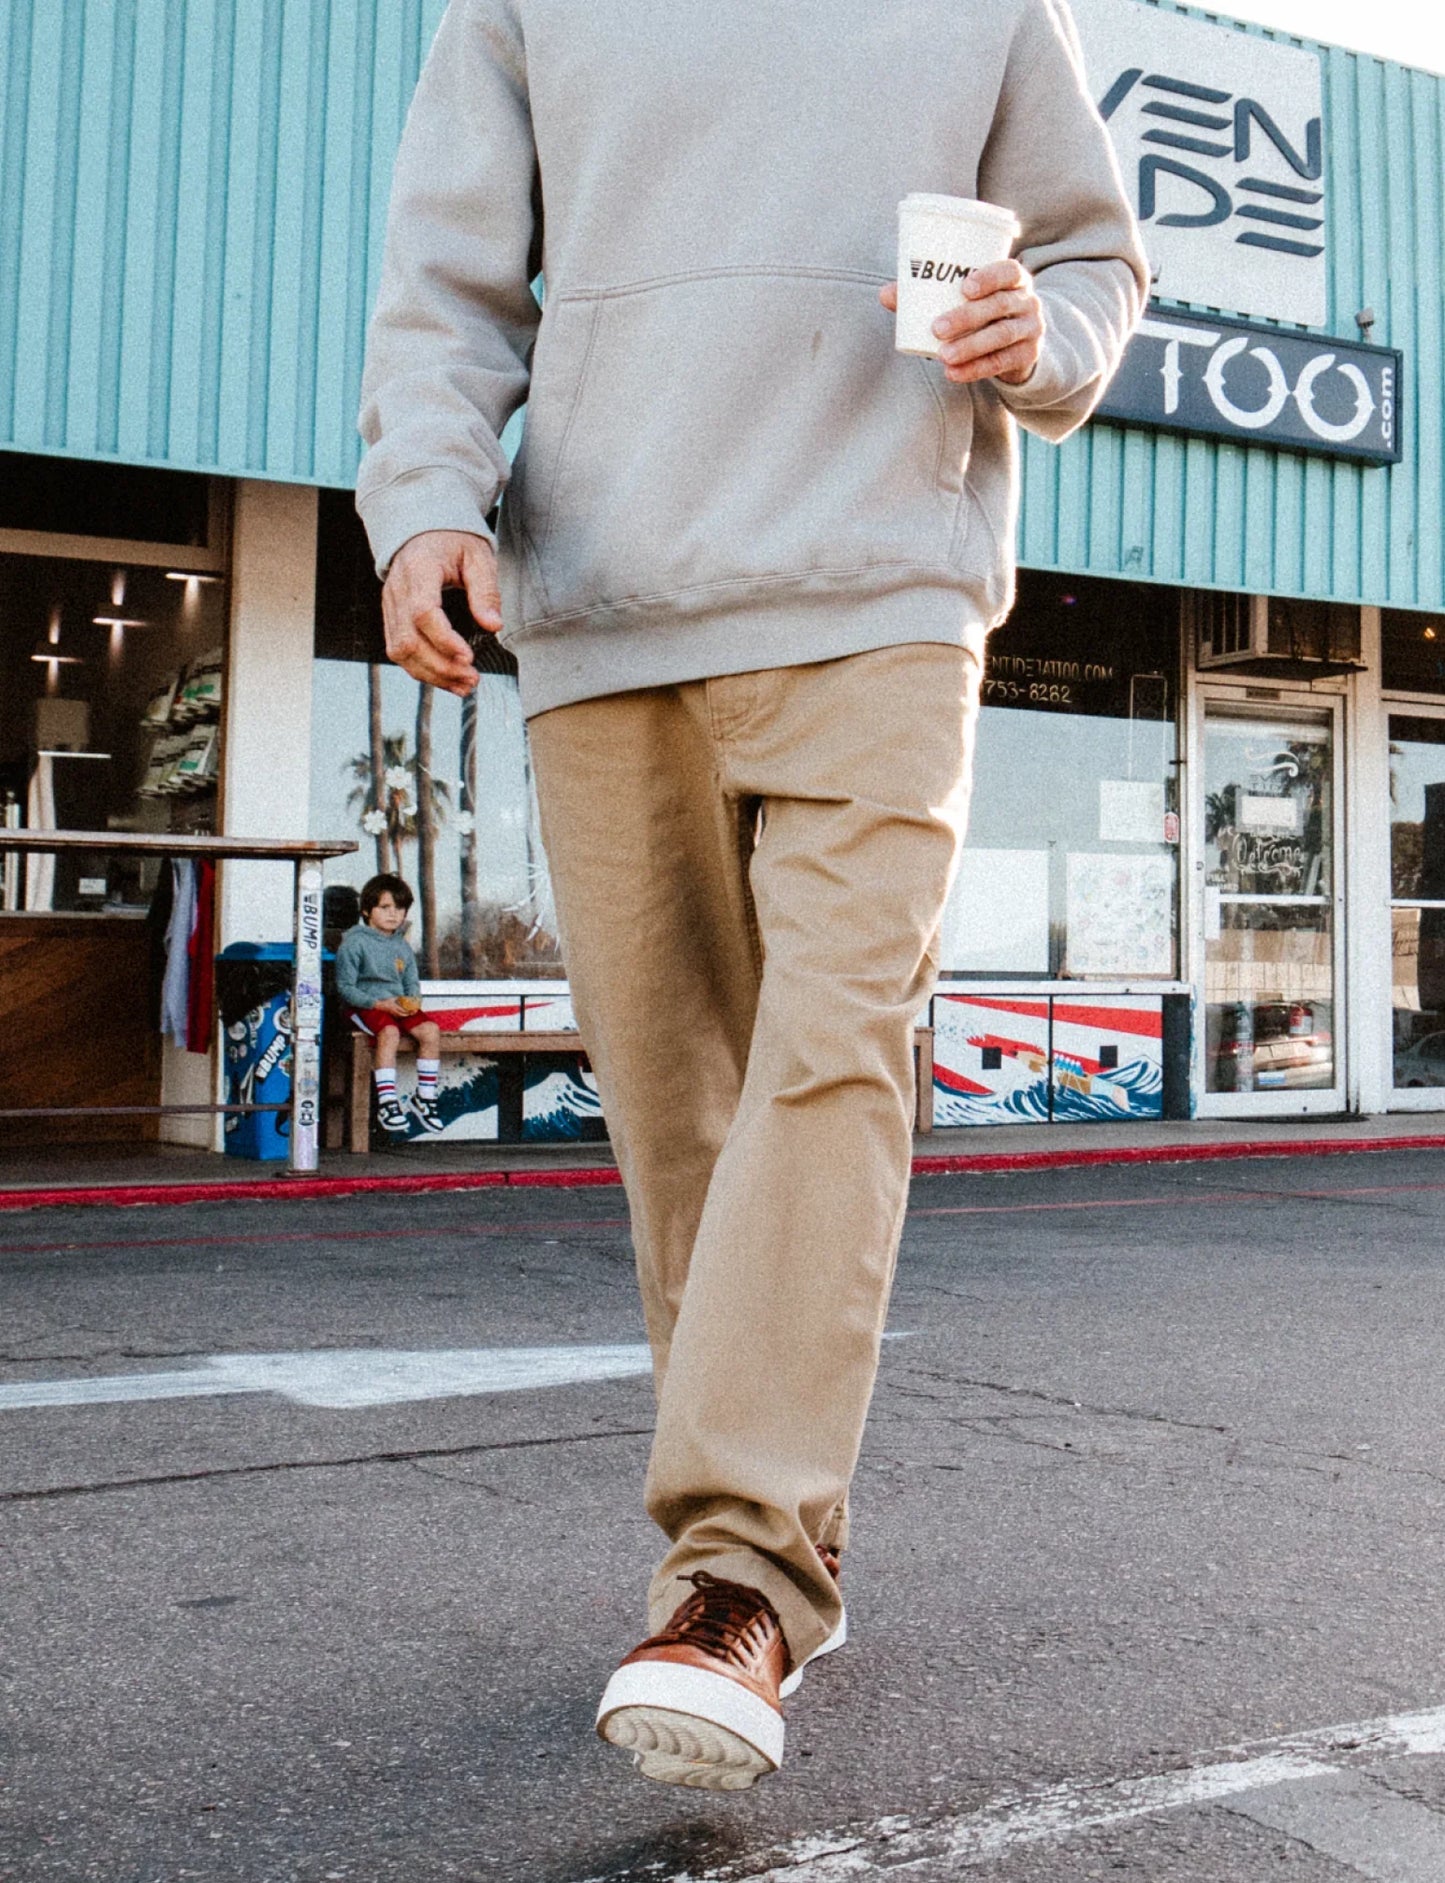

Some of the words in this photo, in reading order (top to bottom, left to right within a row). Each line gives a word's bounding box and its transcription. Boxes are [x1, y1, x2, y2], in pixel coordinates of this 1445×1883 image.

[921, 261, 978, 283] BUM
[303, 904, 318, 950] BUMP
[259, 1033, 286, 1073] BUMP
